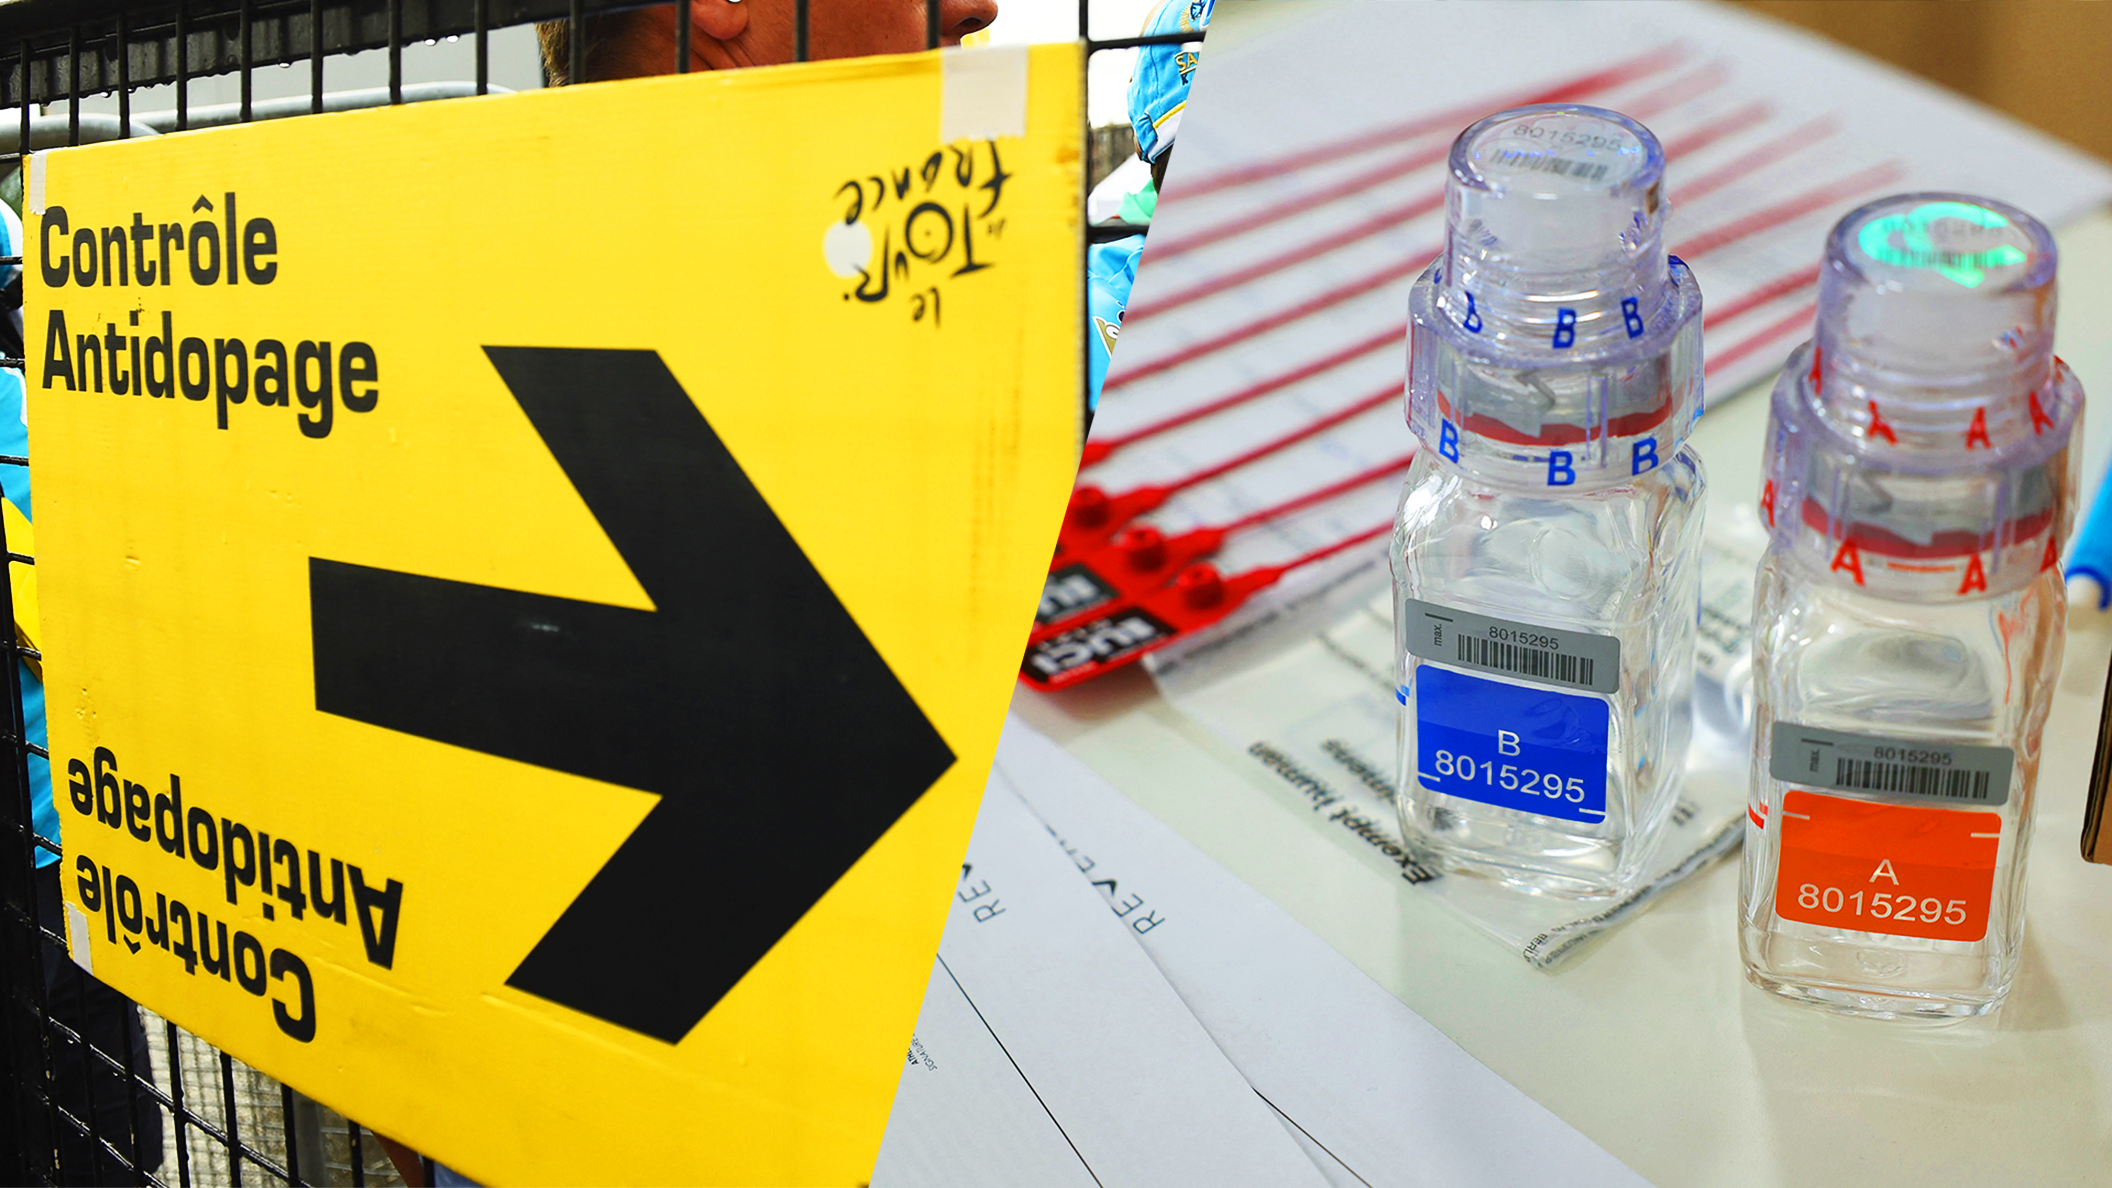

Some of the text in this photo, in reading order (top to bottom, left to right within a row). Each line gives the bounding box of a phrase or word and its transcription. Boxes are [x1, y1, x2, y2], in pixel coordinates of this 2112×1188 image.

[40, 191, 279, 288] Contrôle
[1551, 307, 1578, 350] B
[1620, 296, 1645, 340] B
[42, 309, 379, 439] Antidopage
[1438, 418, 1660, 487] B B B
[1965, 406, 1993, 451] A
[1830, 538, 1867, 588] A
[1957, 553, 1988, 596] A
[1432, 623, 1444, 647] max.
[1488, 625, 1560, 651] 8015295
[1498, 729, 1521, 757] B
[1873, 745, 1953, 766] 8015295
[1434, 749, 1586, 803] 8015295
[1248, 740, 1440, 886] Exempt human
[67, 746, 403, 971] Antidopage
[1868, 858, 1899, 886] A
[1797, 883, 1967, 925] 8015295
[76, 853, 318, 1043] Contrôle
